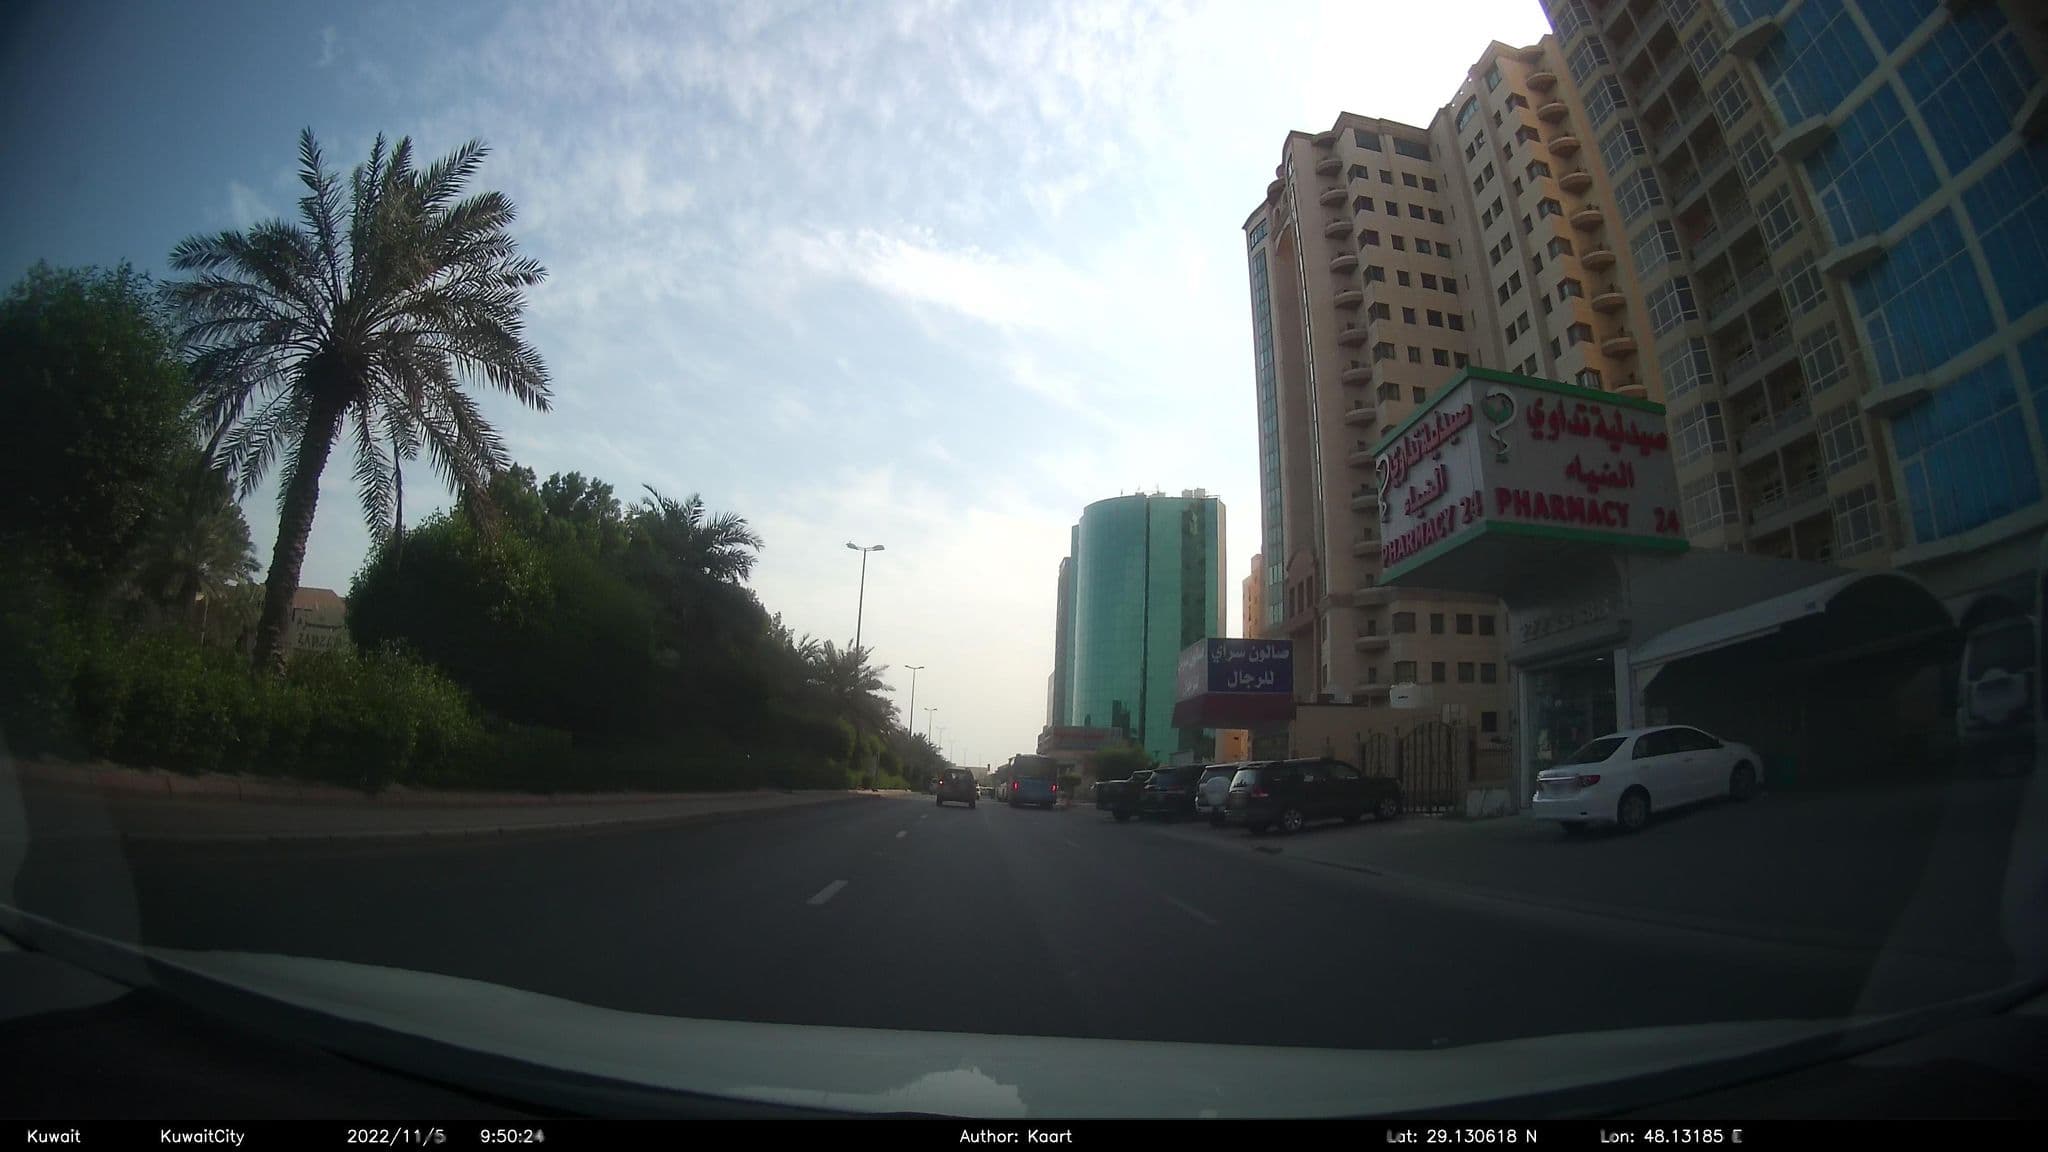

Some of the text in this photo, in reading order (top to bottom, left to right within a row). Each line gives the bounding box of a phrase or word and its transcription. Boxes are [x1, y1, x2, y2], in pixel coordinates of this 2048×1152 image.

[1526, 397, 1668, 456] صيدلية تداوي
[1494, 486, 1681, 533] PHARMACY 24
[1381, 505, 1456, 568] PHARMACY
[1210, 644, 1246, 664] سراي
[1248, 644, 1290, 663] صالون
[1227, 670, 1274, 688] للرجال
